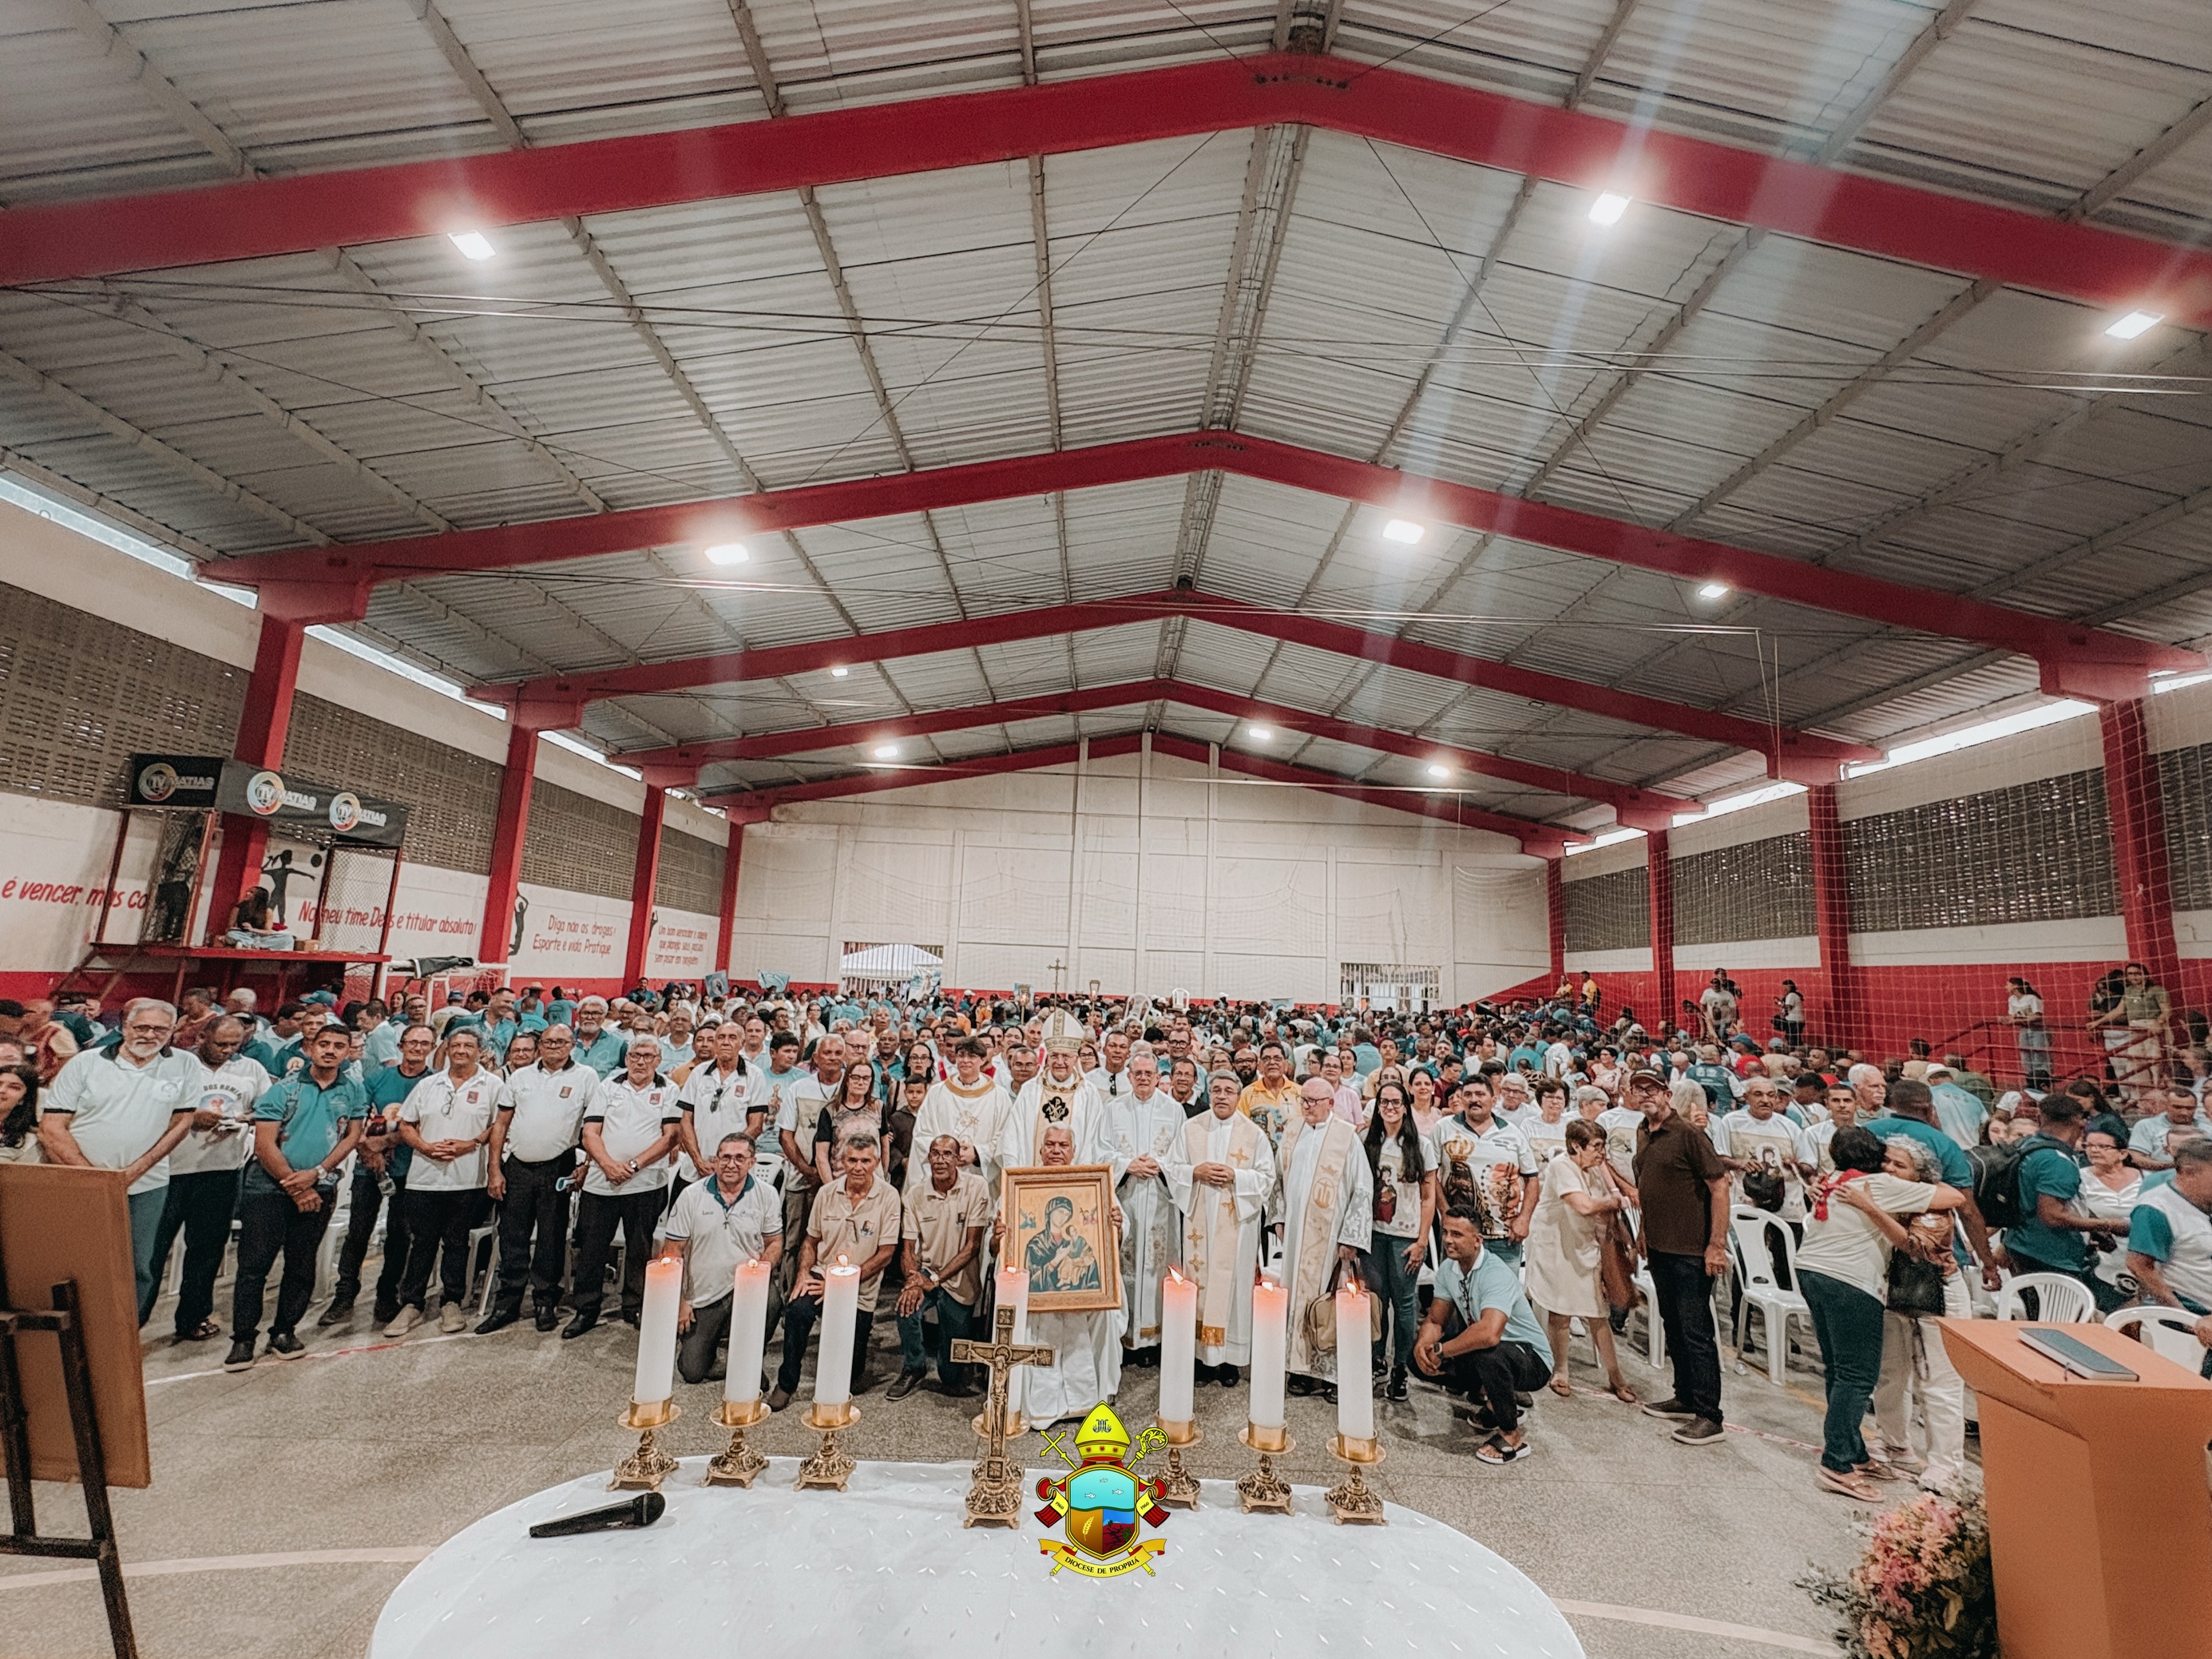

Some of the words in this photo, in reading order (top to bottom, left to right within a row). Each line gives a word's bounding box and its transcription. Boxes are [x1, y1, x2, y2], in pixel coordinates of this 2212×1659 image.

[259, 787, 274, 799] TV
[278, 789, 316, 806] MATIAS
[338, 804, 351, 816] TV
[85, 888, 125, 907] ms
[344, 907, 369, 926] time
[370, 907, 395, 929] Des
[406, 911, 438, 932] titular
[548, 915, 565, 935] Diga
[533, 934, 561, 952] Esporte
